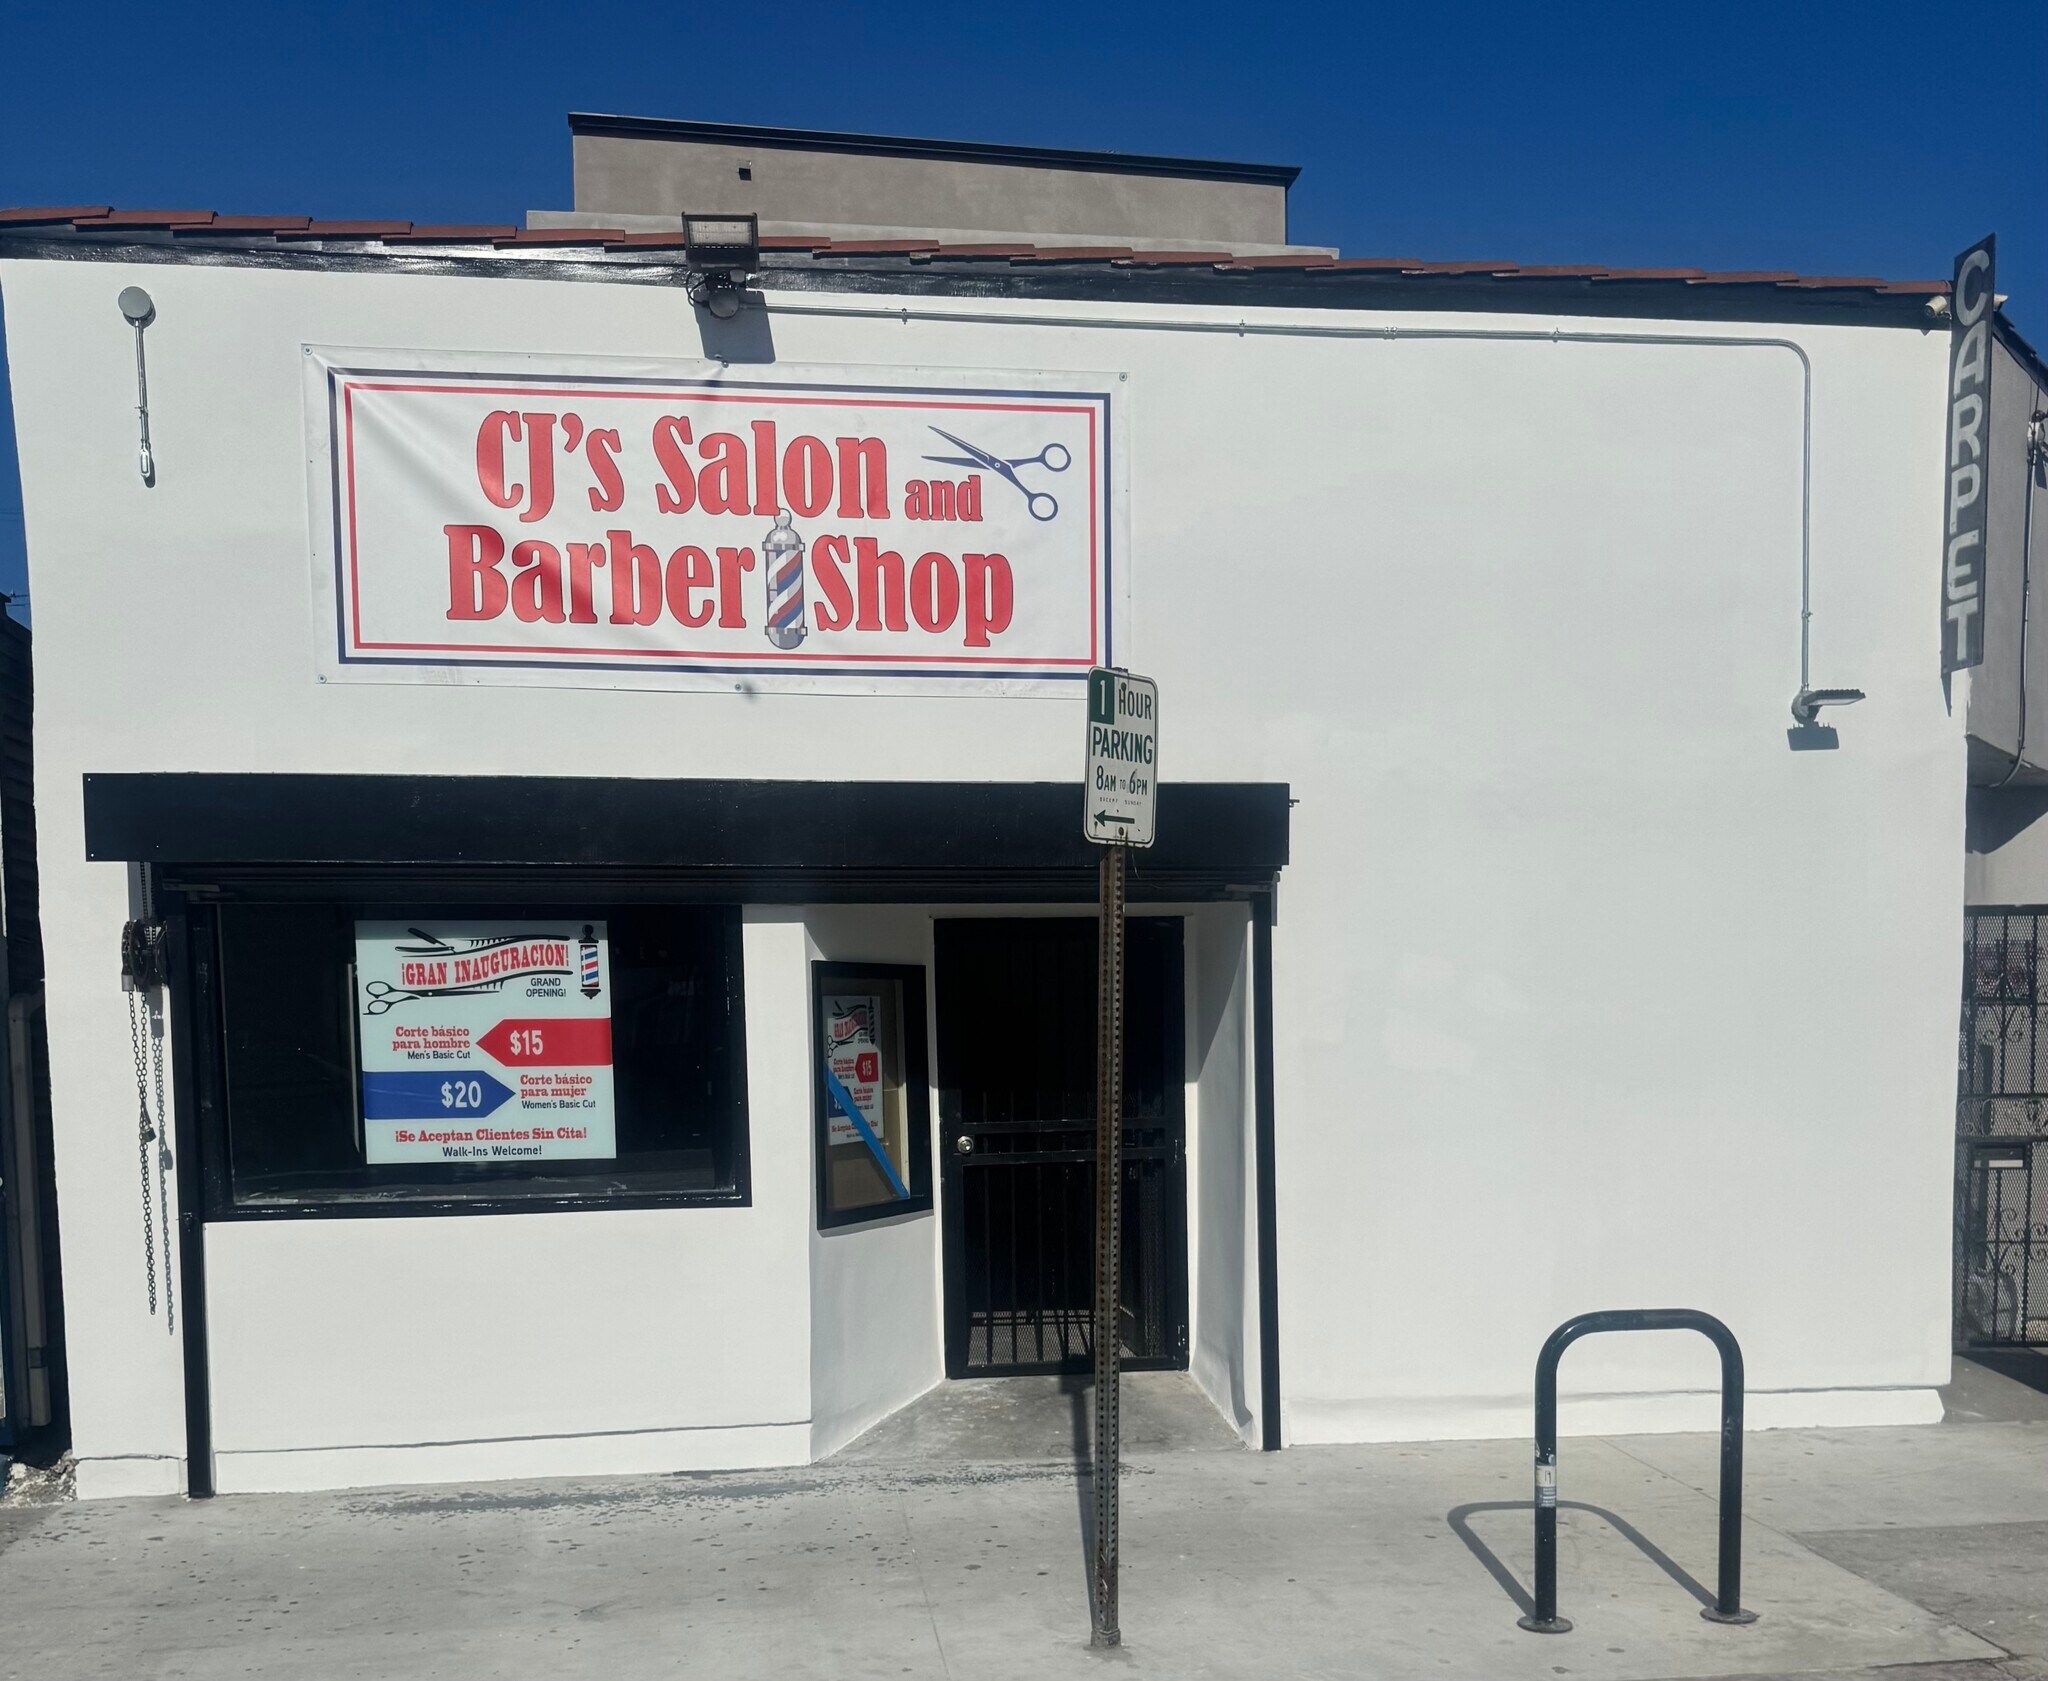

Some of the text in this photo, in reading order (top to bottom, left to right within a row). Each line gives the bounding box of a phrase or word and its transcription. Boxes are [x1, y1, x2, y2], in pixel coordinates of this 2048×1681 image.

[1946, 249, 1990, 661] CARPET
[475, 410, 984, 524] CJ's Salon and
[443, 524, 1015, 648] Barber Shop
[1100, 679, 1152, 721] 1 HOUR
[1092, 726, 1153, 765] PARKING
[402, 962, 447, 986] ¡GRAN
[530, 978, 561, 987] GRAND
[526, 988, 567, 998] OPENING!
[395, 1025, 470, 1038] Corte básico
[392, 1037, 471, 1051] para hombre
[509, 1029, 544, 1056] $15
[407, 1050, 471, 1060] Men's Basic Cut
[862, 1060, 872, 1077] $15
[520, 1073, 592, 1086] Corte básico
[440, 1080, 482, 1108] $20
[520, 1086, 587, 1099] para mujer
[521, 1099, 596, 1110] Women's Basic Cut
[395, 1127, 587, 1144] ¡Se Aceptan Clientes Sin Cita!
[443, 1145, 542, 1157] Walk-Ins Welcome!
